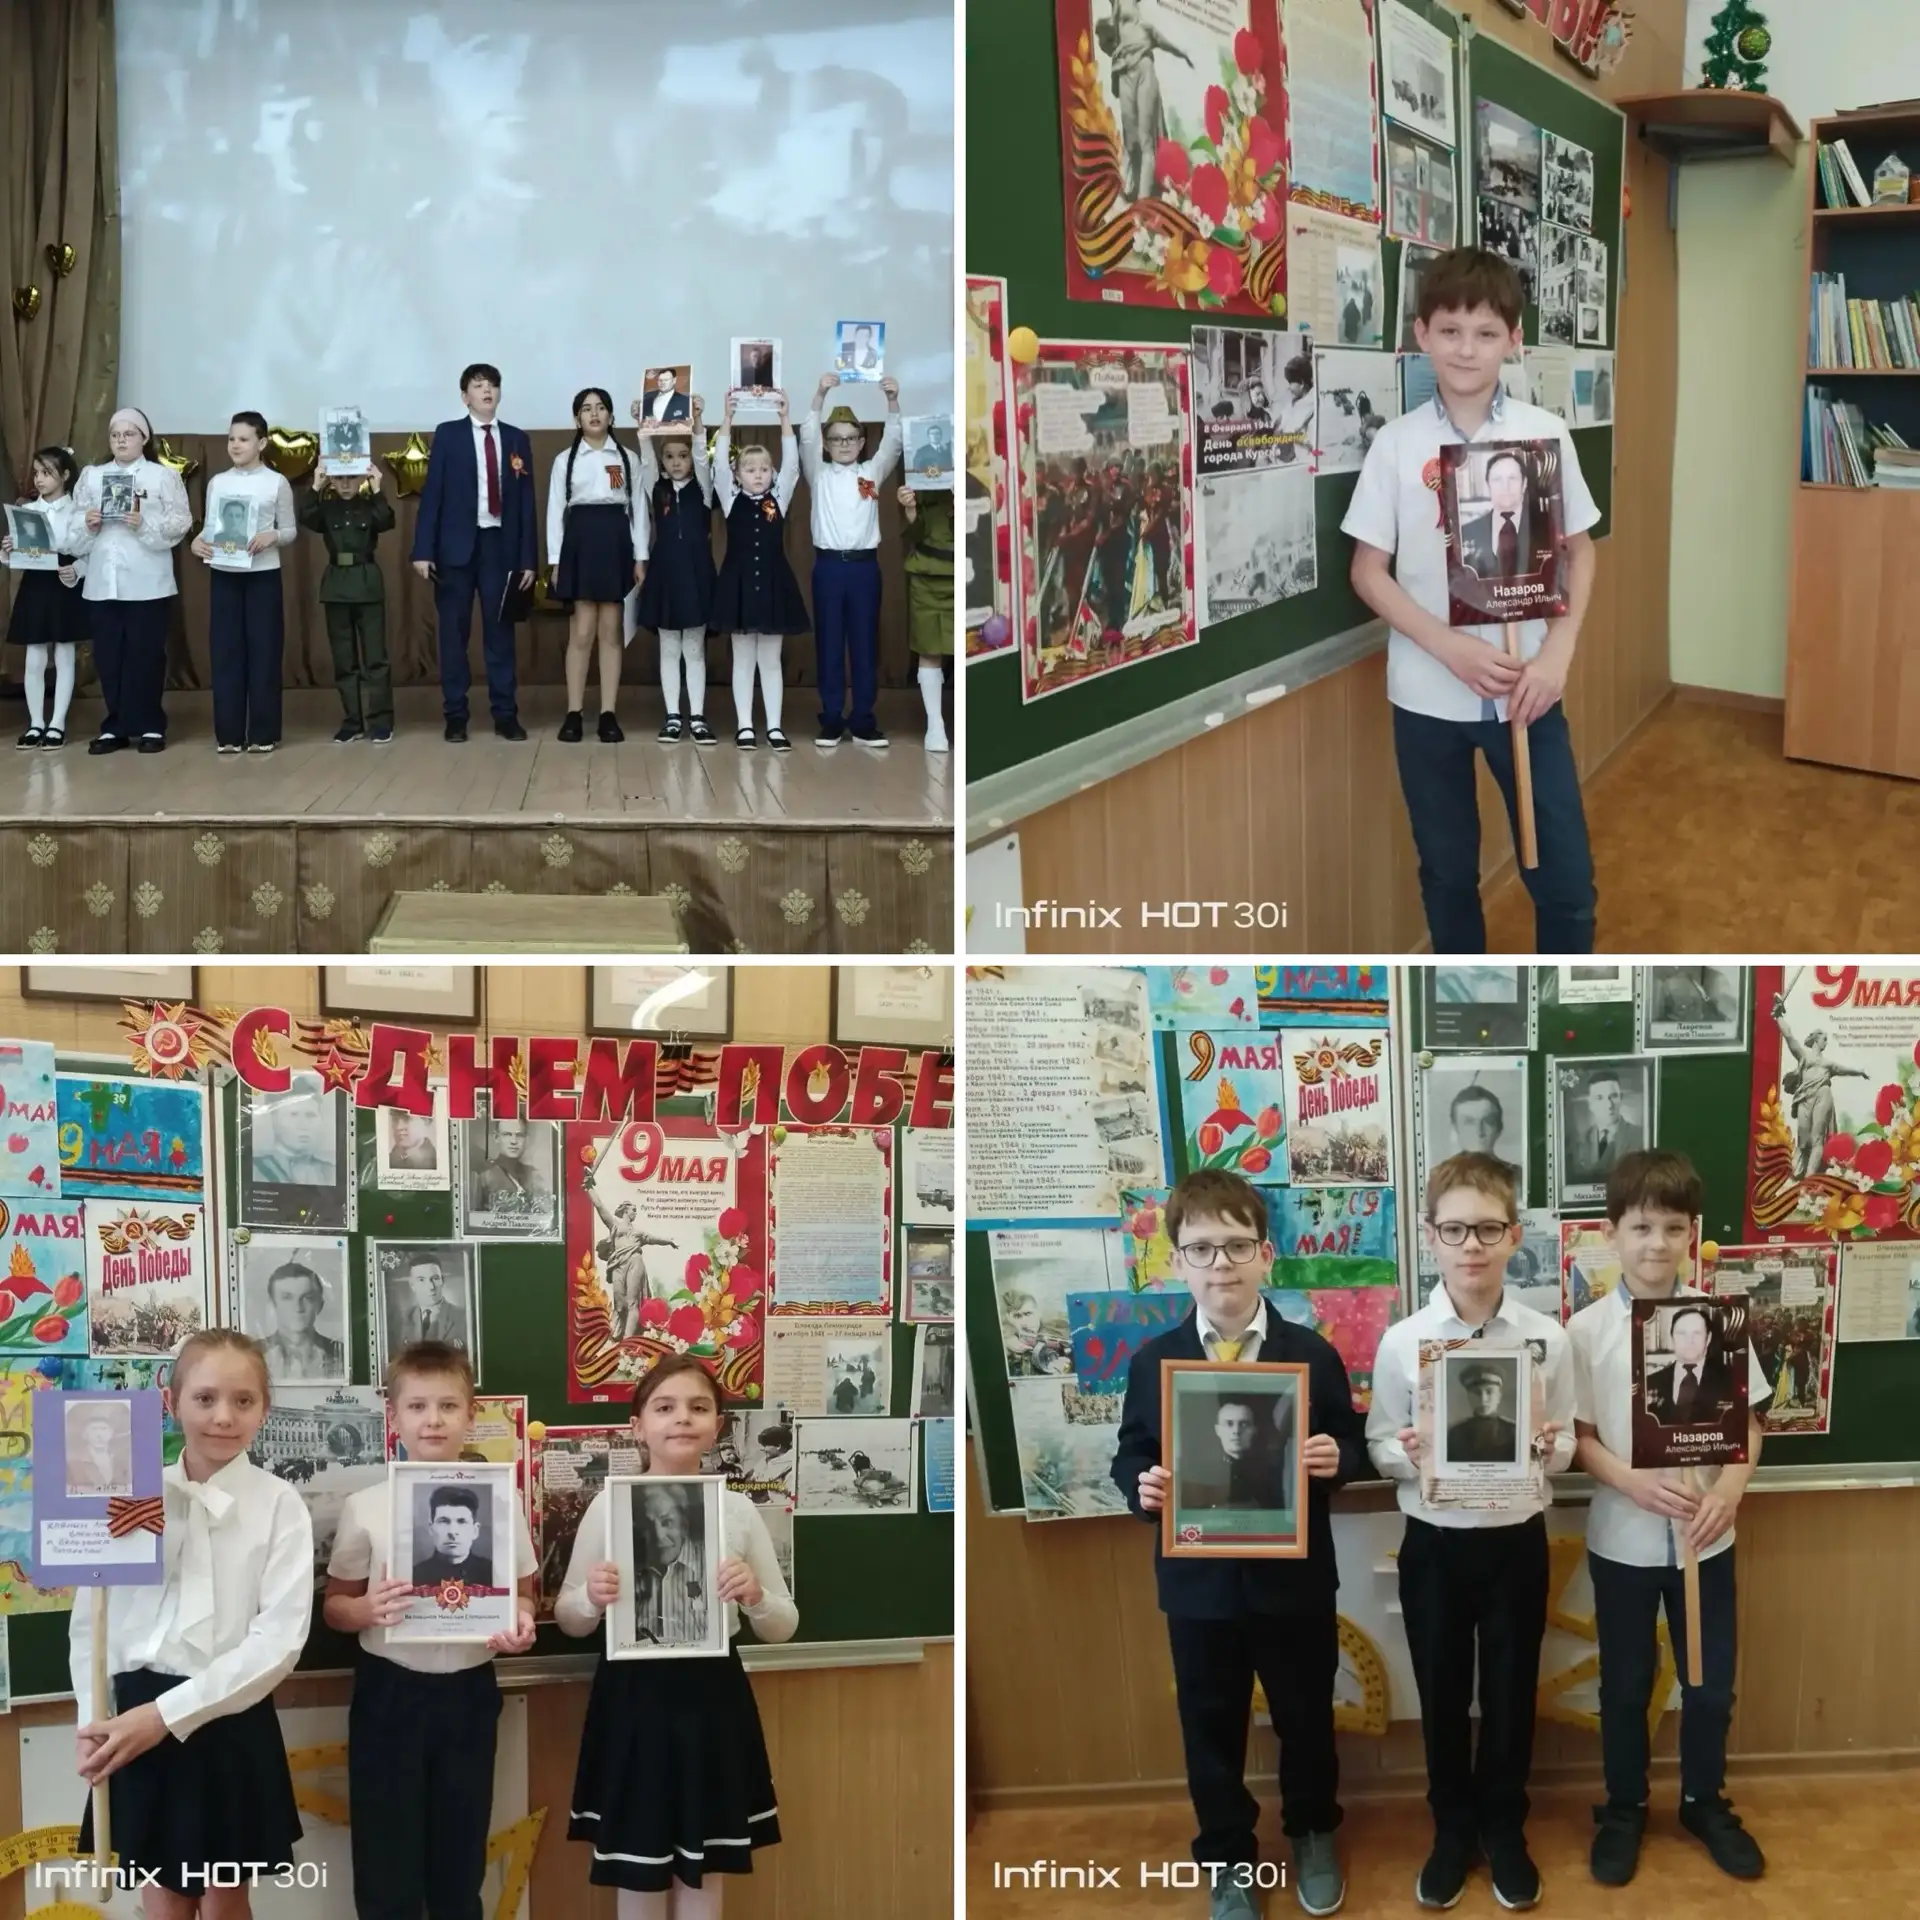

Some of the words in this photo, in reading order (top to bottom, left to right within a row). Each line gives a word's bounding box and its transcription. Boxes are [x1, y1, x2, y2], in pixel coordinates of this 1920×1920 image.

[1204, 425, 1210, 433] 8
[1211, 424, 1252, 432] Февраля
[1204, 439, 1232, 452] День
[1204, 451, 1243, 465] города
[1246, 448, 1281, 460] Курска
[1486, 597, 1533, 609] Александр
[1535, 592, 1562, 603] Ильич
[1494, 583, 1545, 597] Назаров
[231, 1006, 293, 1094] С
[354, 1023, 658, 1123] ДНЕМ
[1185, 1030, 1215, 1081] 9
[1299, 1084, 1329, 1127] День
[1329, 1074, 1379, 1112] Победы
[8, 1101, 56, 1122] МАЯ
[59, 1122, 84, 1167] 9
[89, 1129, 162, 1167] МАЯ
[618, 1122, 665, 1183] 9
[657, 1155, 729, 1184] МАЯ
[13, 1206, 84, 1239] МАЯ!
[102, 1255, 136, 1297] День
[138, 1246, 192, 1284] Победы
[1665, 1443, 1711, 1454] Александр
[1712, 1441, 1741, 1451] Ильич
[1673, 1432, 1724, 1444] Назаров
